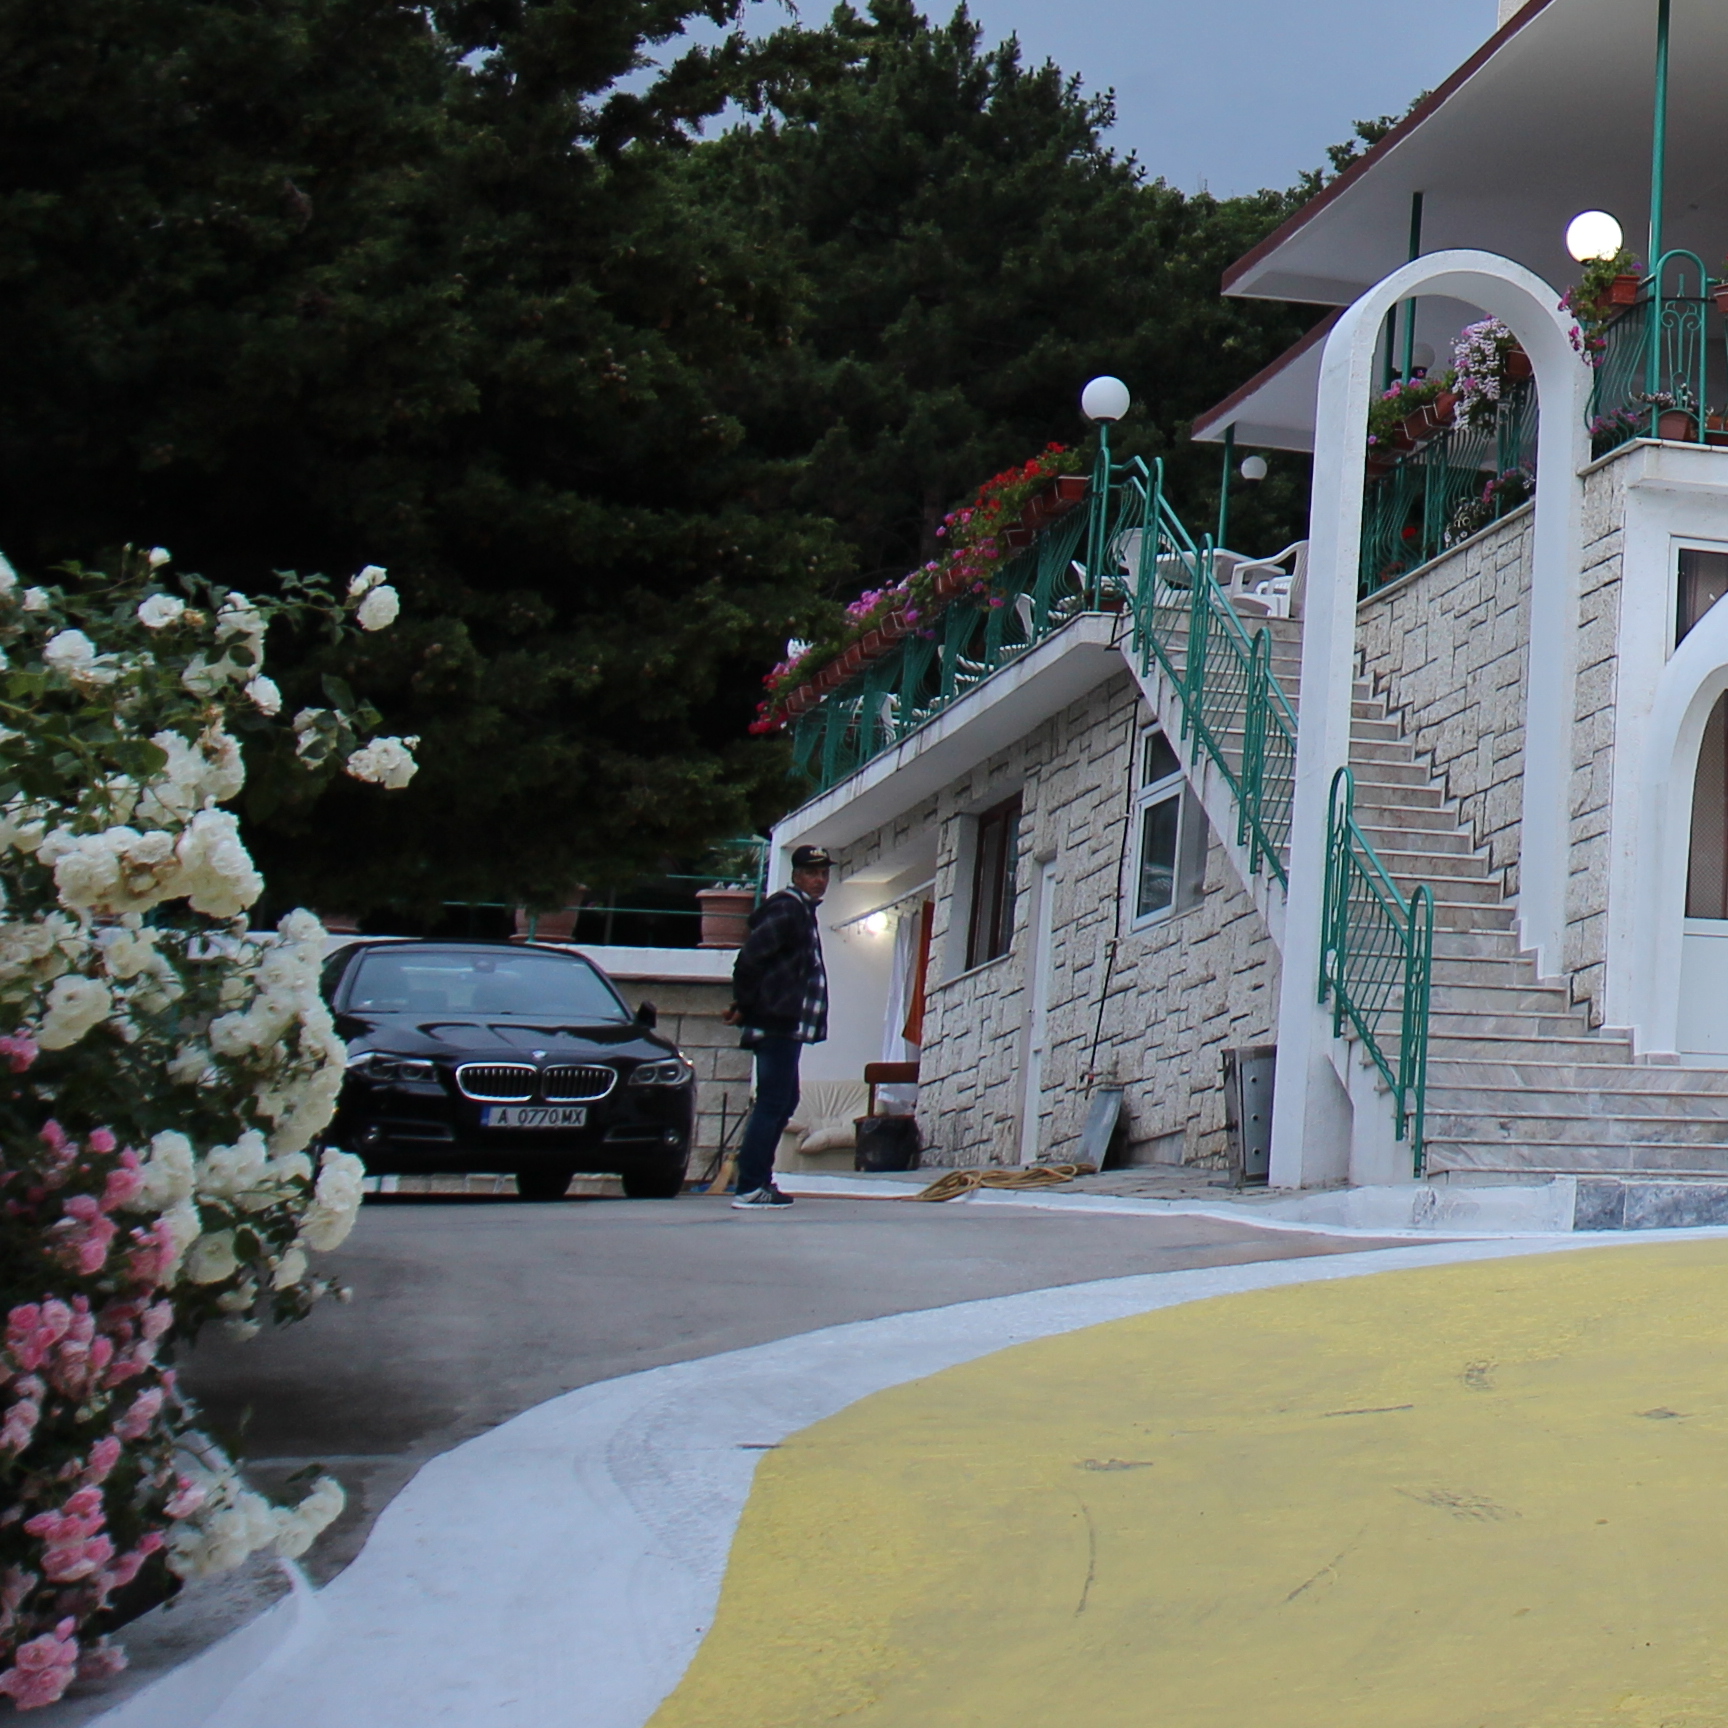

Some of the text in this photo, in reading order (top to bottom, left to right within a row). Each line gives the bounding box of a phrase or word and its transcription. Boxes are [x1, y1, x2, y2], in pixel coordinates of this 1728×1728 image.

[498, 1109, 508, 1124] A
[518, 1109, 558, 1124] 0770
[561, 1109, 583, 1124] MX
